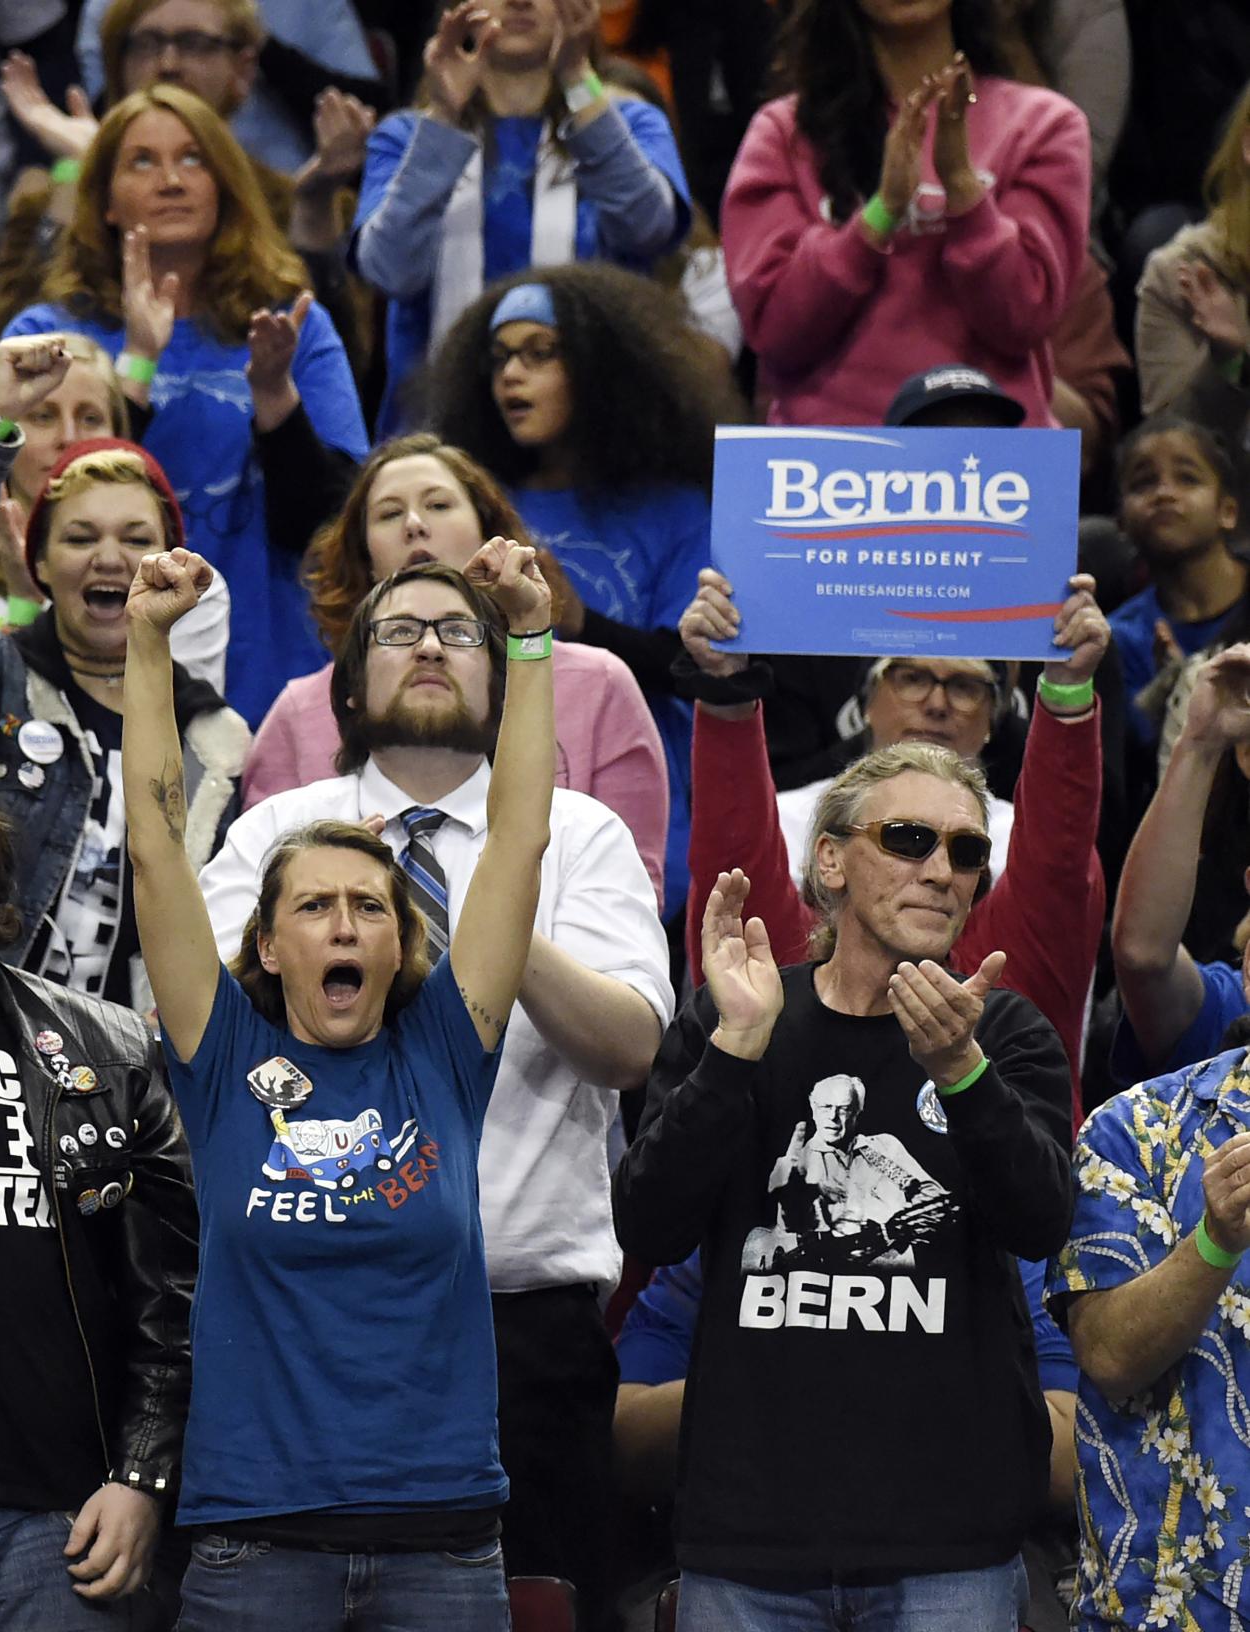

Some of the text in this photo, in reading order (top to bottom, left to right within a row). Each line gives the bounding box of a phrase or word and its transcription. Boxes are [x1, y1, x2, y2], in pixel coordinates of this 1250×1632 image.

[765, 453, 1031, 523] Bernie
[806, 549, 983, 568] FOR PRESIDENT
[815, 582, 972, 600] BERNIESANDERS.COM
[246, 1134, 441, 1223] FEEL THE BERN
[738, 1270, 947, 1334] BERN
